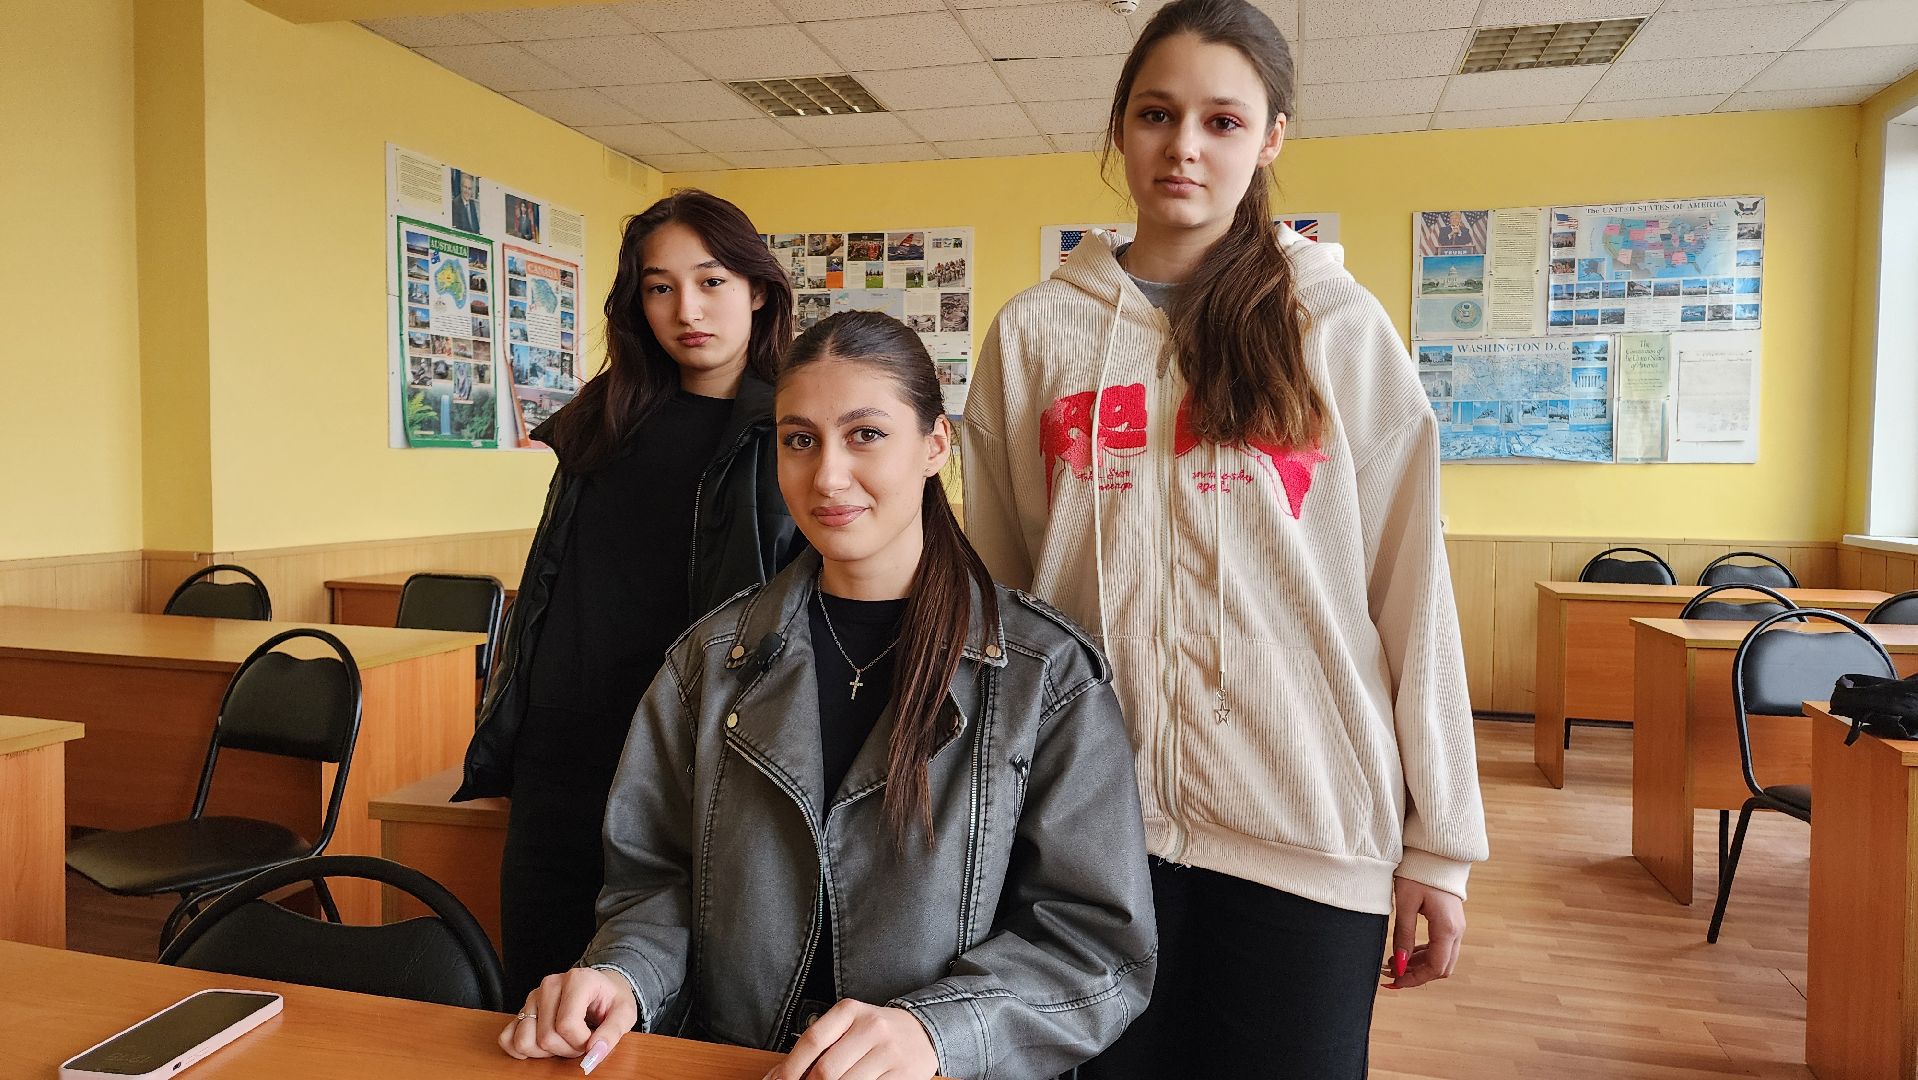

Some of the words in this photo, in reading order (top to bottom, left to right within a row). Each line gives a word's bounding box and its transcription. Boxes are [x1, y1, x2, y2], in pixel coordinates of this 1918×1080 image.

[1637, 203, 1670, 212] STATES
[1687, 201, 1728, 209] AMERICA
[431, 239, 468, 257] AUSTRALIA
[1457, 342, 1540, 353] WASHINGTON
[1545, 341, 1569, 352] D.C.
